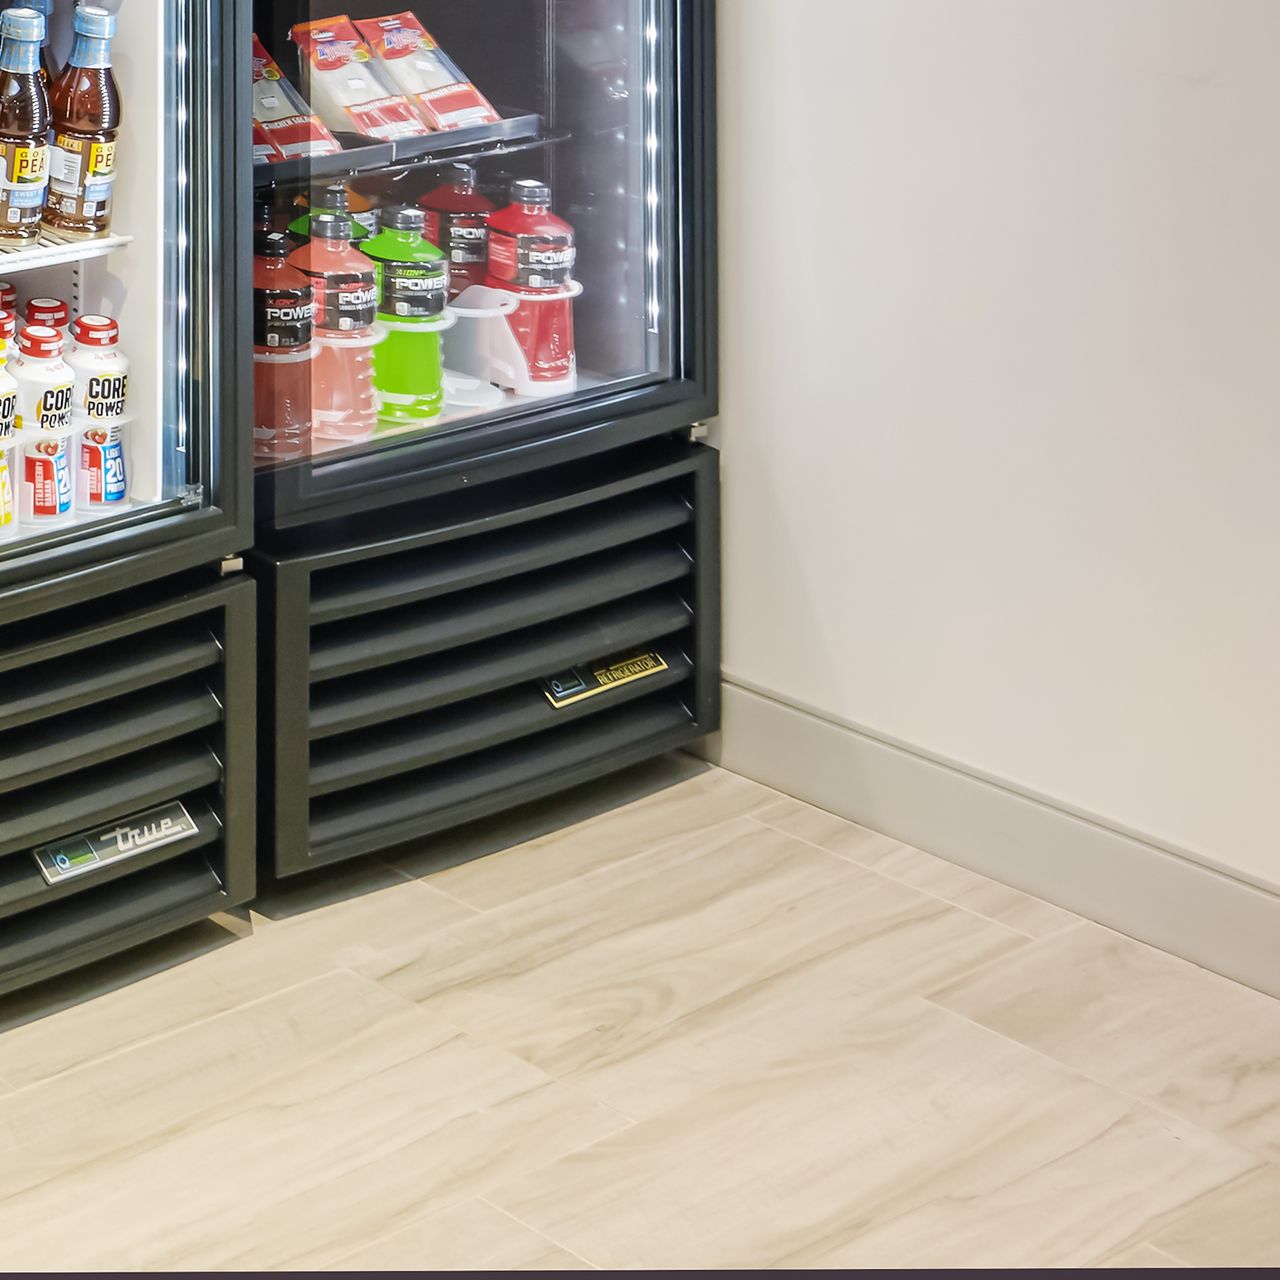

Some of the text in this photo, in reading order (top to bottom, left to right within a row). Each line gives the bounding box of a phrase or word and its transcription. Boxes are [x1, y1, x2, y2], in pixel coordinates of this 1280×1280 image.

[88, 375, 128, 399] CORE
[87, 400, 125, 417] POWER
[105, 458, 123, 482] 20
[596, 657, 657, 686] REFRIGERATOR
[99, 817, 184, 852] true
